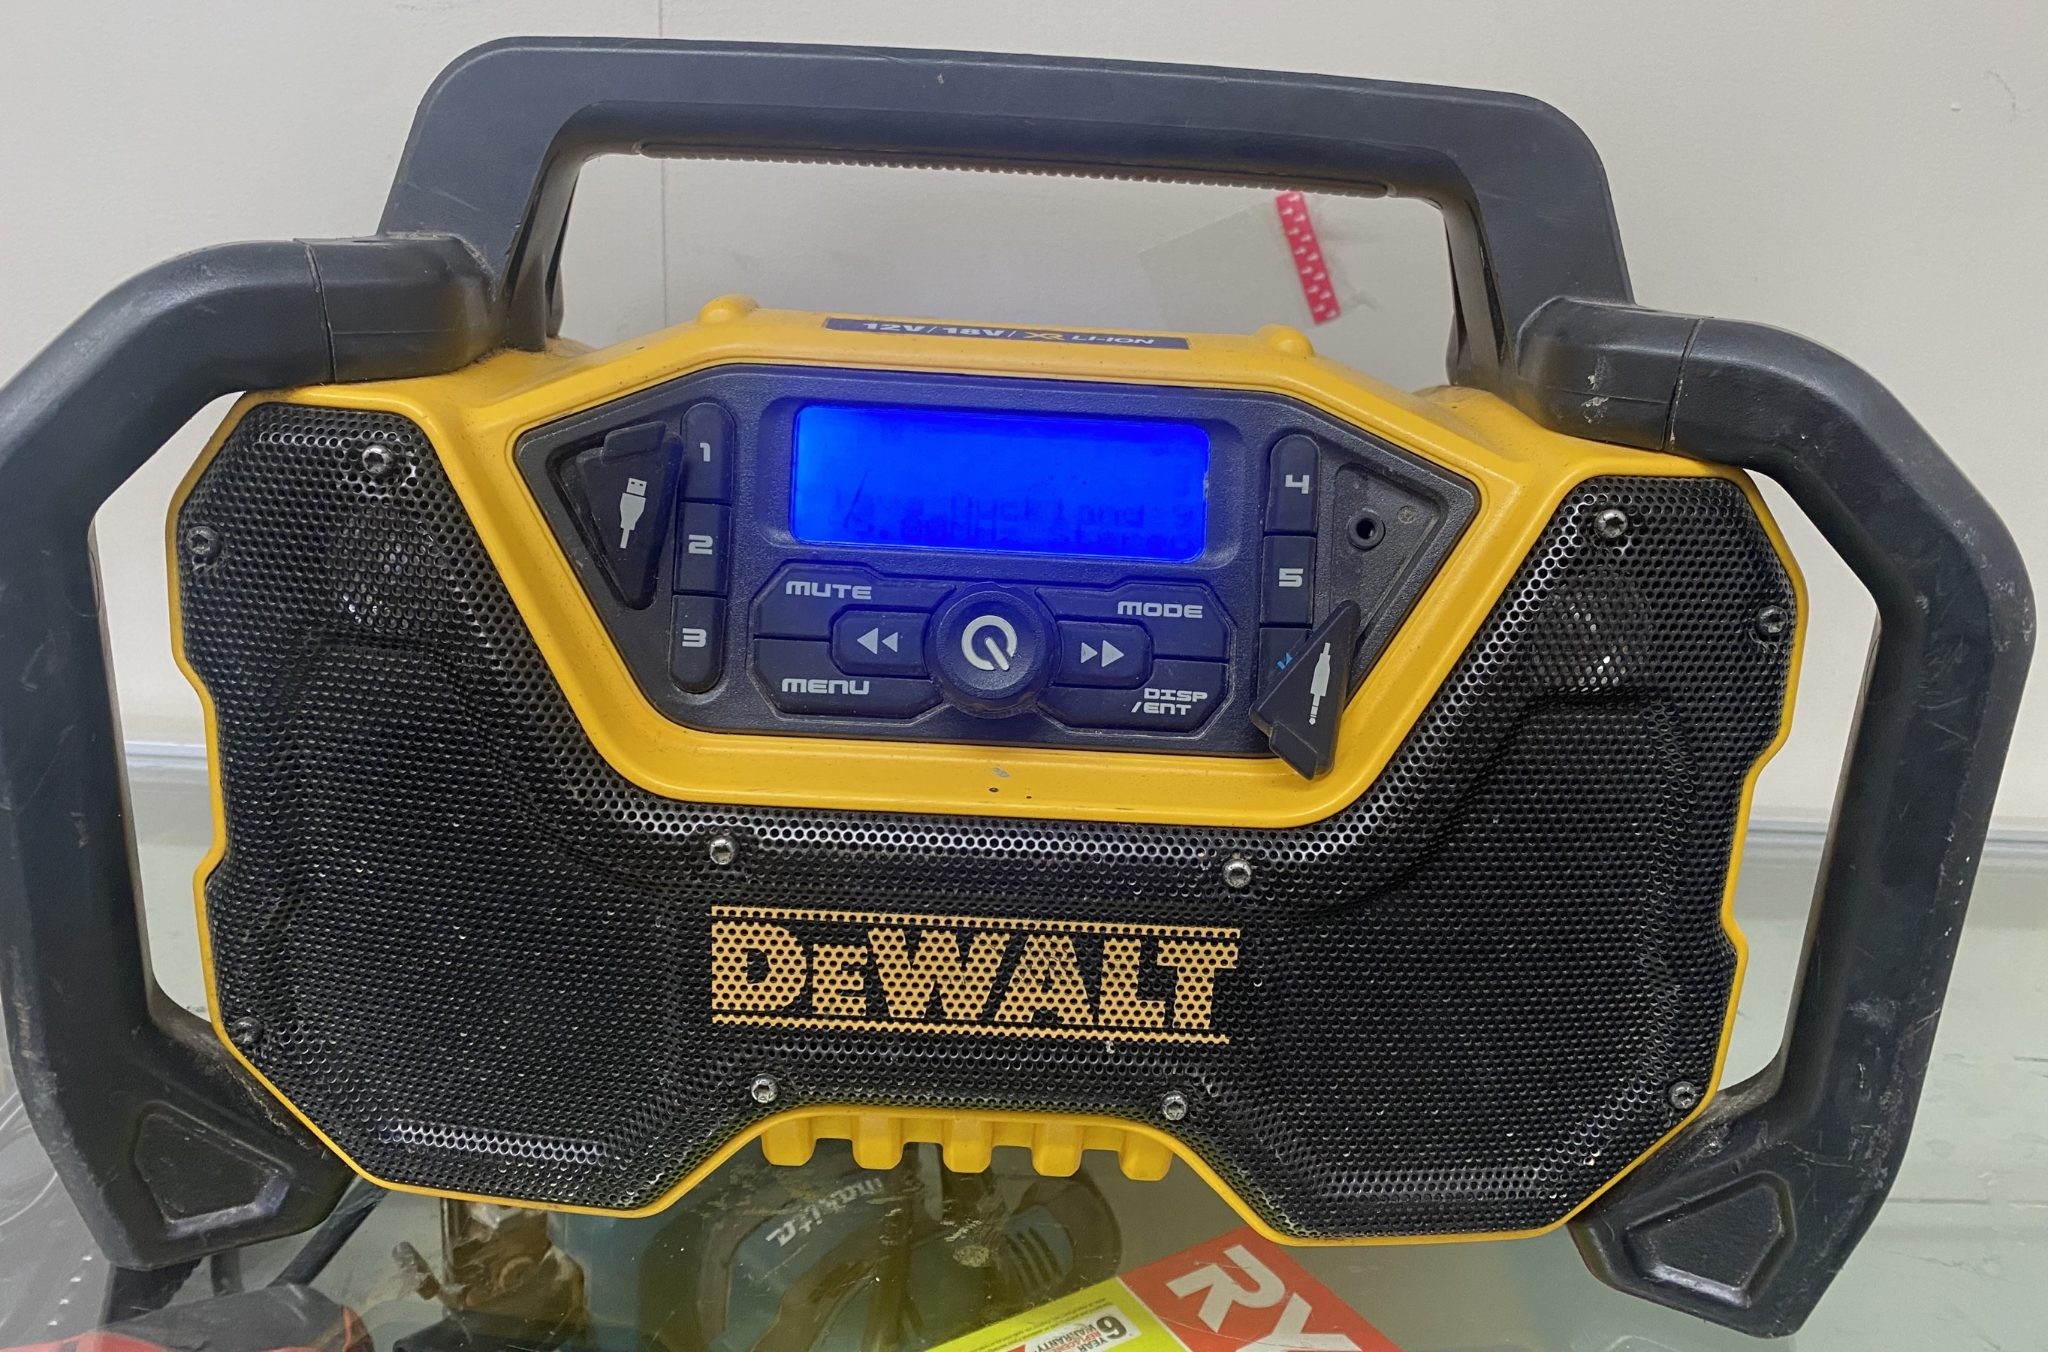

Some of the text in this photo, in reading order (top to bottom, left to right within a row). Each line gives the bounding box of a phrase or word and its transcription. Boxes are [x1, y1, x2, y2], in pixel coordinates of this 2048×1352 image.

[1071, 335, 1155, 345] LI-ION
[699, 442, 711, 462] 1
[1285, 474, 1310, 495] 4
[688, 534, 714, 555] 2
[1278, 567, 1304, 588] 5
[785, 580, 872, 600] MUTE
[1117, 601, 1203, 619] MODE
[681, 627, 707, 648] 3
[781, 678, 870, 696] MENU
[1143, 687, 1208, 702] DISP
[1131, 701, 1192, 716] /ENT
[711, 920, 1239, 1030] DEWALT
[1096, 1315, 1128, 1340] 6
